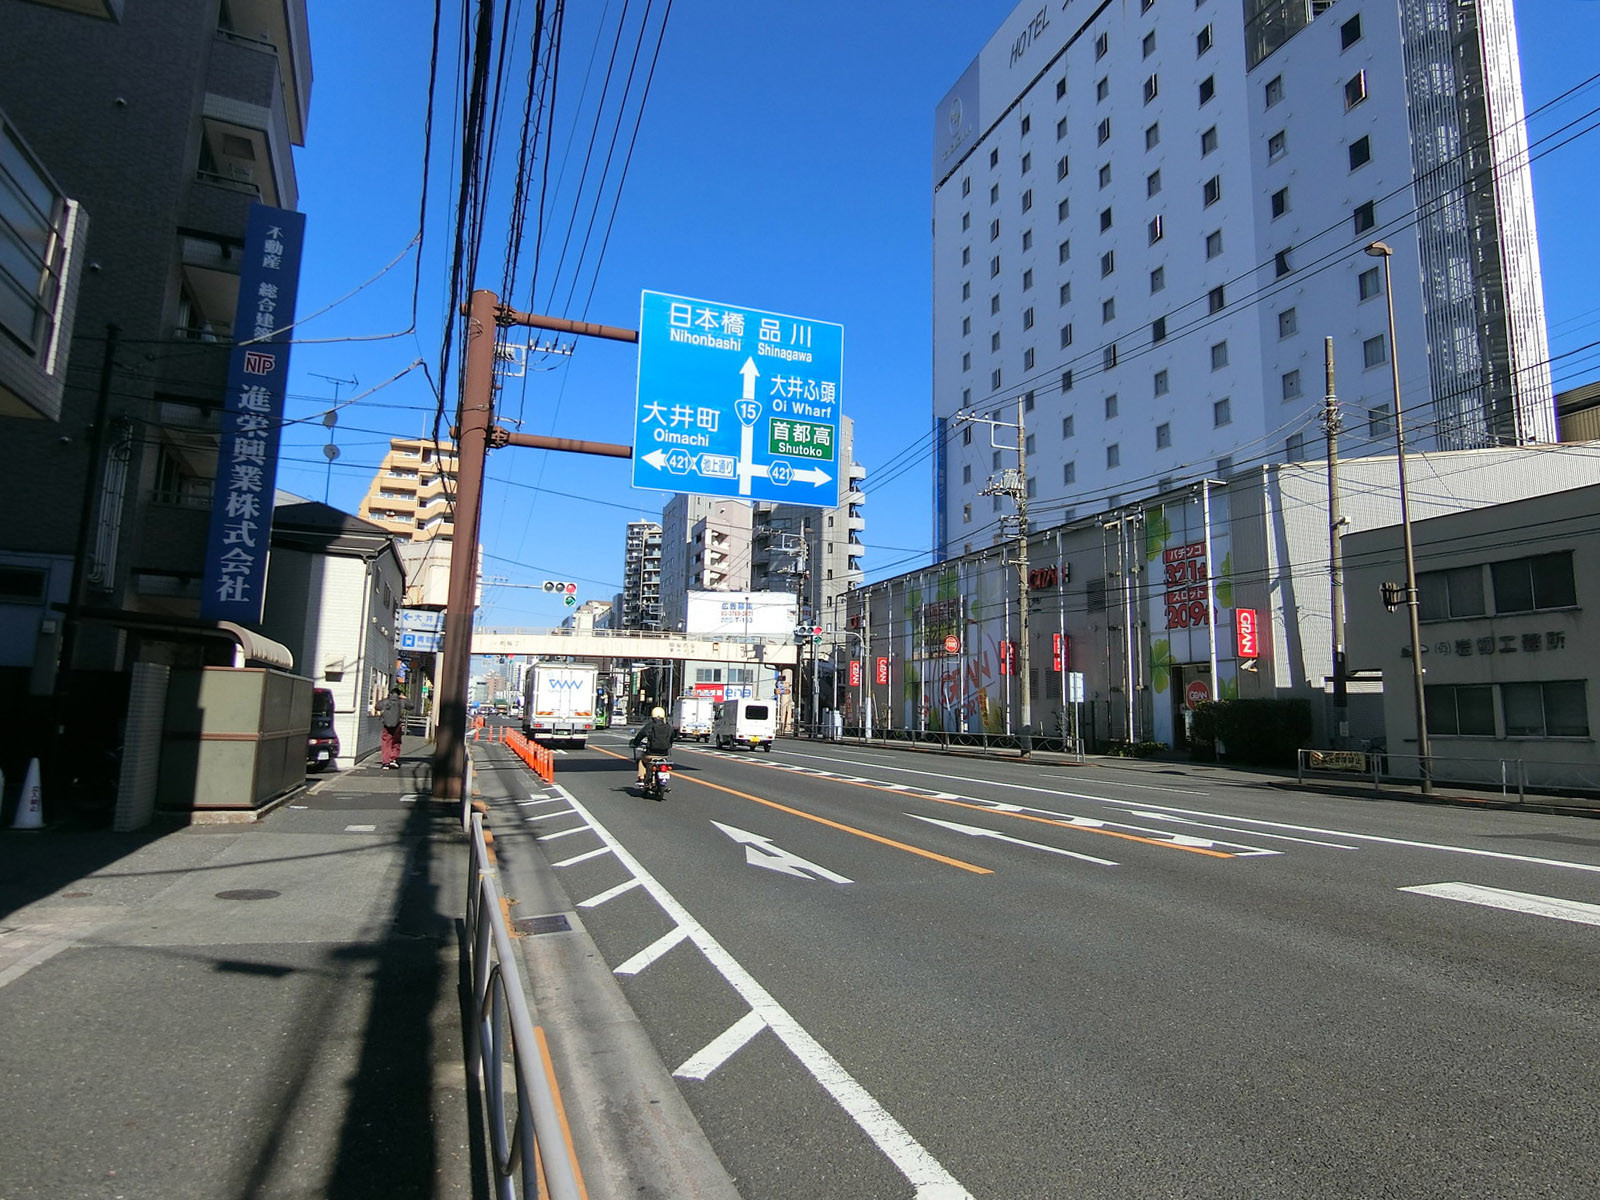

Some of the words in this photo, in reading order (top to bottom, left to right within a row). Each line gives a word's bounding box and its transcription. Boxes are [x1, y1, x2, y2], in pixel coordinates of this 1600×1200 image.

[1009, 4, 1050, 68] HOTEL
[262, 225, 284, 270] 不動産
[670, 303, 744, 337] 日本橋
[670, 328, 742, 352] Nihonbashi
[759, 318, 812, 348] 品川
[244, 351, 275, 375] NTP
[758, 342, 813, 363] Shinagawa
[770, 374, 836, 405] 大井ふ頭
[642, 401, 721, 433] 大井町
[740, 404, 757, 419] 15
[772, 400, 787, 413] Oi
[792, 403, 832, 418] Wharf
[654, 429, 710, 447] Oimachi
[772, 421, 831, 446] 首都高
[778, 442, 823, 457] Shutoko
[669, 455, 689, 469] 421
[702, 458, 733, 474] 池上通り
[772, 467, 791, 480] 421
[1170, 545, 1202, 560] パチンコ
[1173, 587, 1204, 601] スロット
[1240, 612, 1253, 653] GRAN
[725, 688, 752, 698] ena
